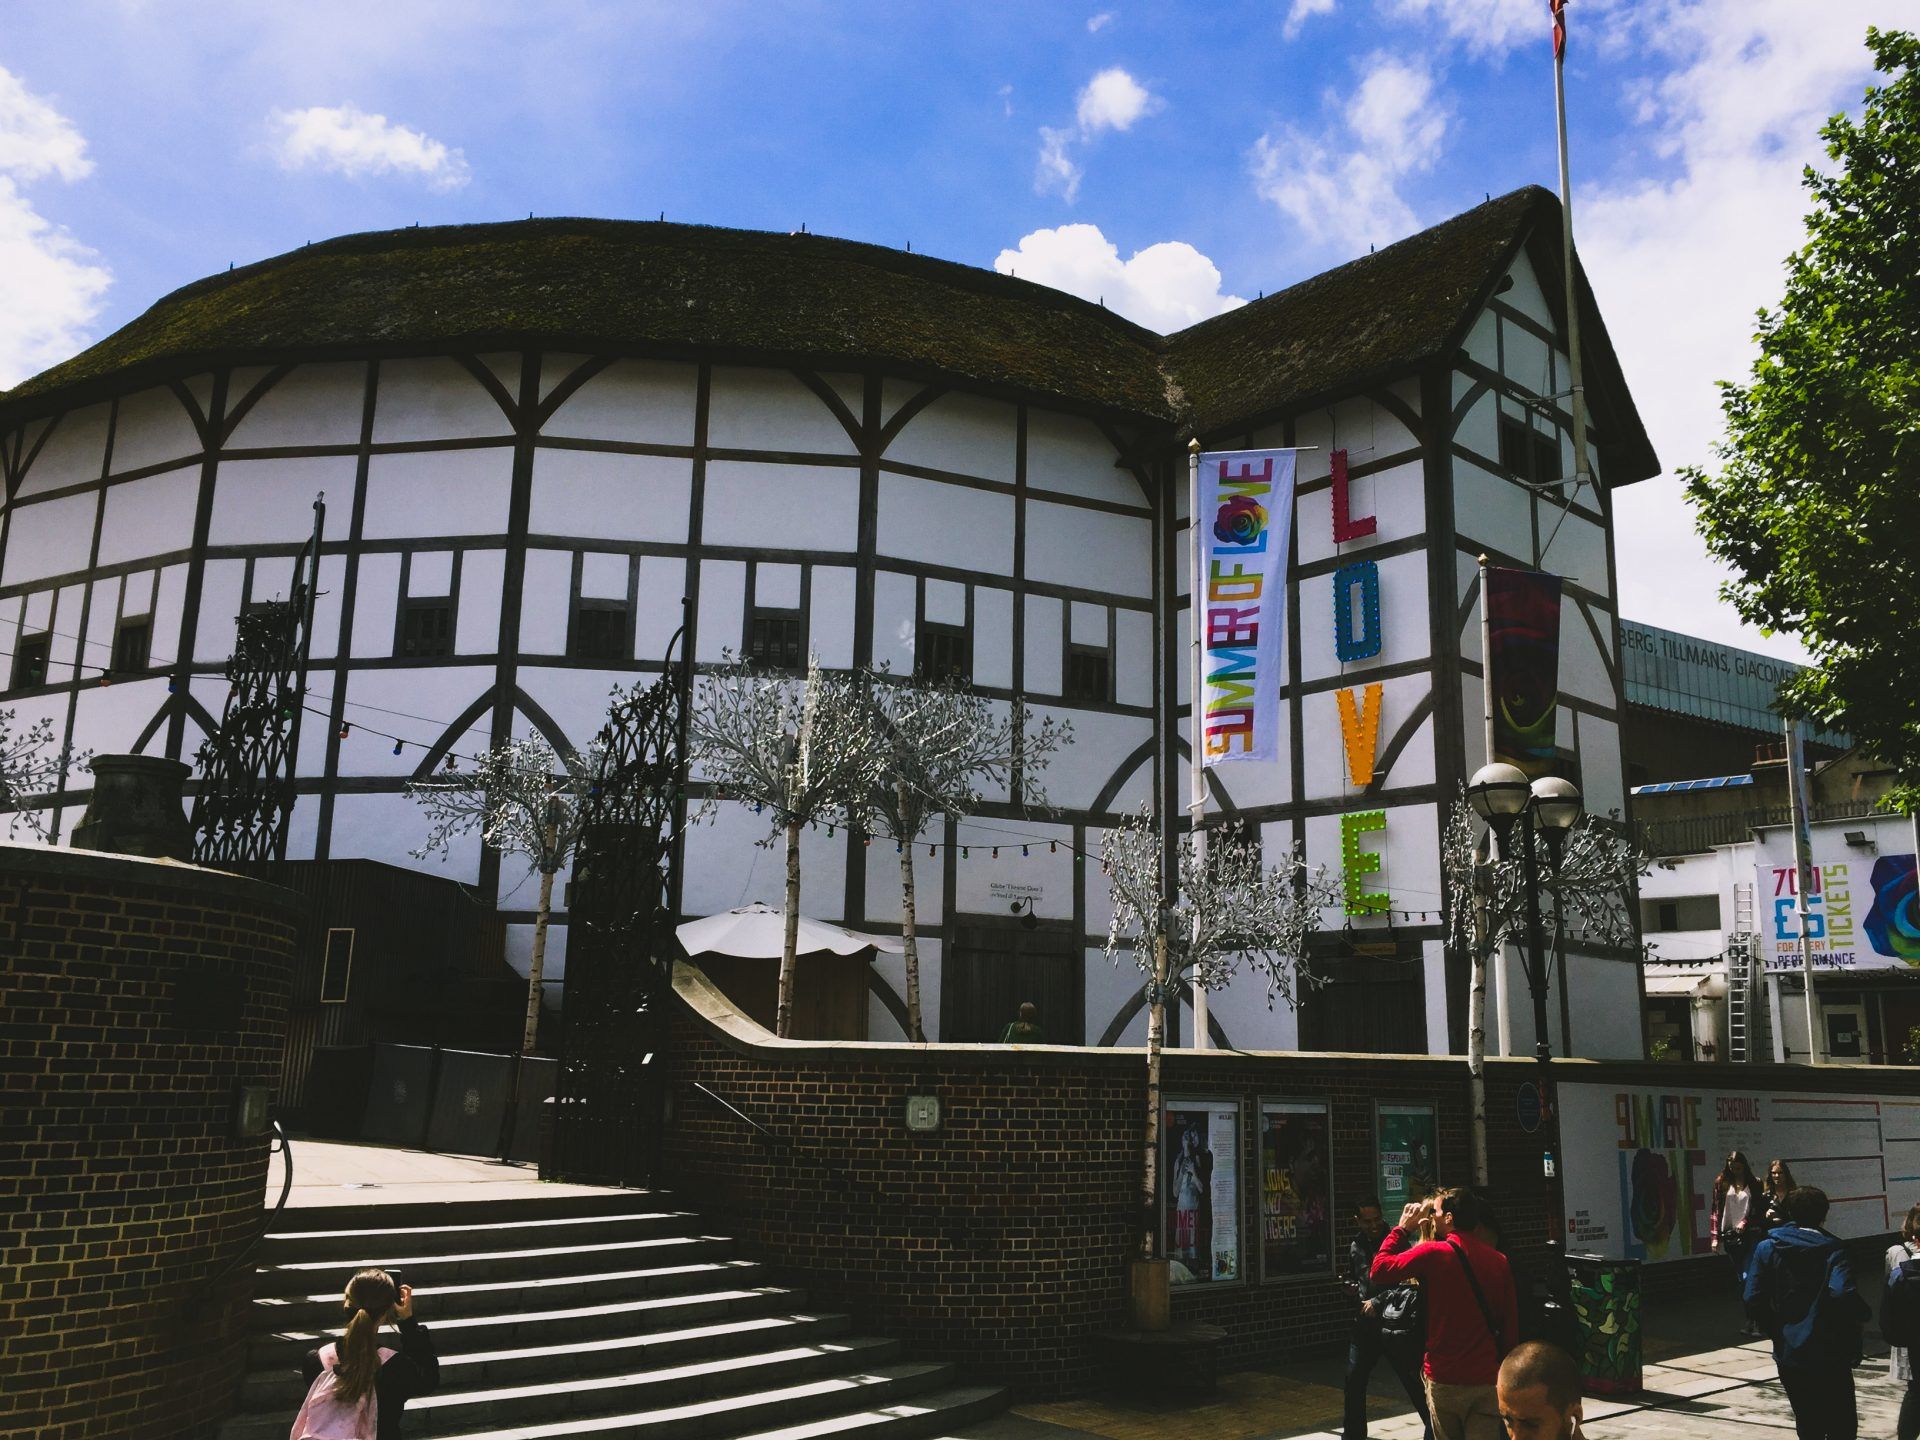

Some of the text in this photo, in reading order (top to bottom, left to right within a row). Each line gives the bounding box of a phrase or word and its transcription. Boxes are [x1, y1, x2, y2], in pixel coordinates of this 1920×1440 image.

[1208, 558, 1264, 602] OF
[1660, 637, 1731, 674] TILLMANS,
[1206, 604, 1260, 756] SUMMER
[1329, 448, 1391, 916] LOVE
[1823, 864, 1854, 950] TICKETS
[1777, 941, 1825, 952] FOR EERY
[1778, 953, 1856, 966] PERFRMANCE
[1716, 1097, 1760, 1122] SCHEDULE
